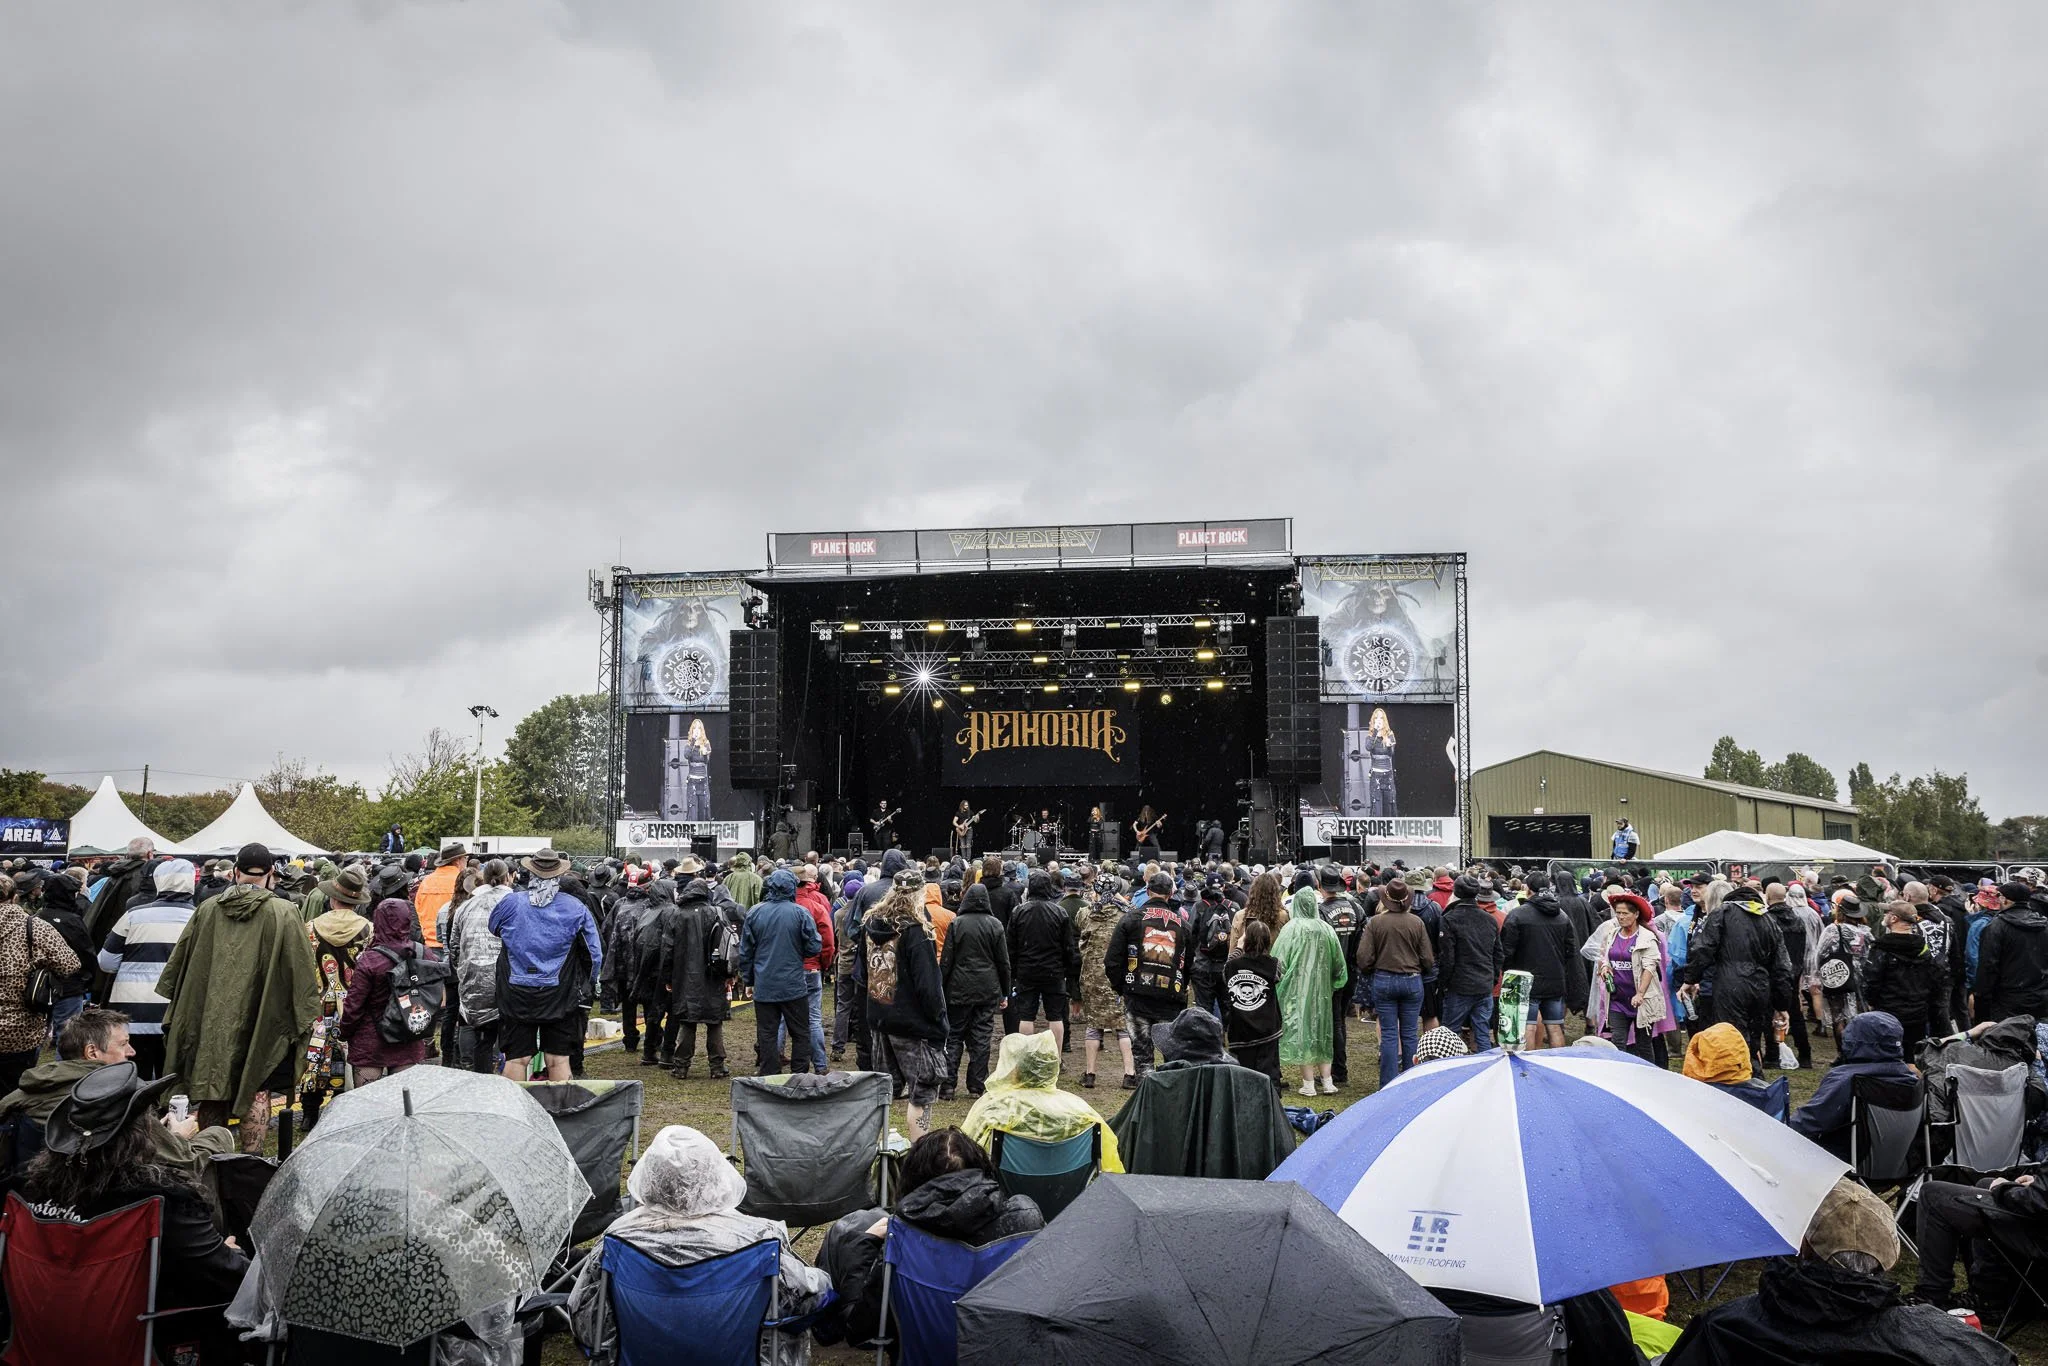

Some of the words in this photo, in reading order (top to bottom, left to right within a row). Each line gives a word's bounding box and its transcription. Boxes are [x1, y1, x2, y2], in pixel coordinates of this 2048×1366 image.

[1178, 531, 1217, 545] PLANET
[1218, 530, 1246, 543] ROCK
[812, 541, 847, 555] PLANET
[848, 540, 875, 554] ROCK
[1352, 636, 1406, 659] MERCIA
[664, 649, 711, 671] MERCIA
[1353, 666, 1406, 690] WHISKY
[664, 677, 711, 700] WHISKY
[2, 828, 43, 843] AREA
[1426, 1258, 1467, 1269] ROOFING
